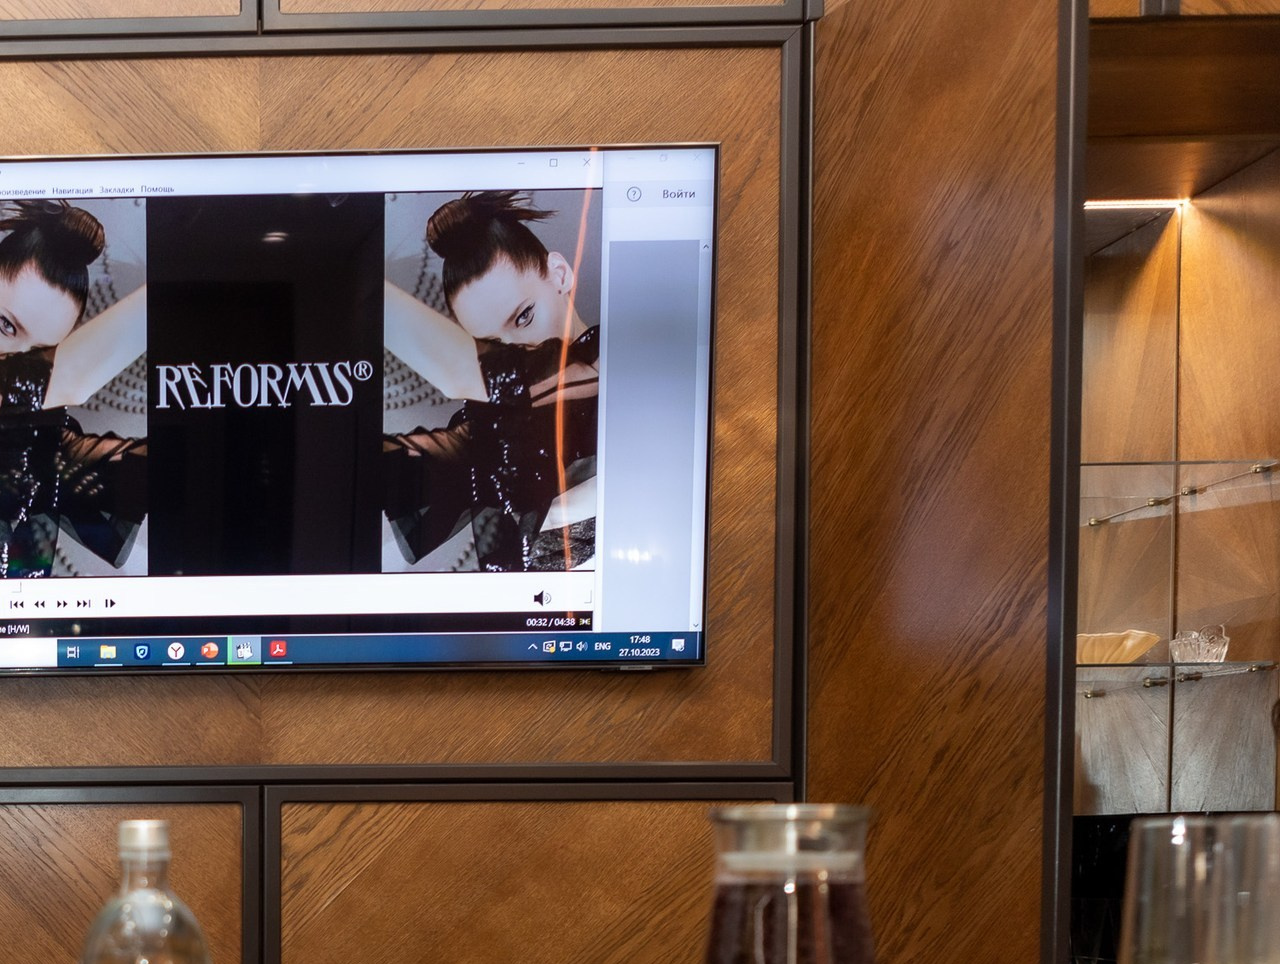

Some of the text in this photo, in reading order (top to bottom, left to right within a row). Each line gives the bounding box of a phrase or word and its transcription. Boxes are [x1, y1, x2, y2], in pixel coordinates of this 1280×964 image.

[52, 187, 93, 196] Навигация
[99, 186, 134, 195] Закладки
[140, 185, 175, 194] Помощь
[662, 188, 696, 199] Войти
[526, 618, 548, 627] 00:32
[554, 618, 575, 627] 04:38
[7, 625, 30, 635] [H/W]
[629, 635, 650, 644] 17:48
[594, 642, 611, 651] ENG
[618, 648, 660, 657] 27.10.2023
